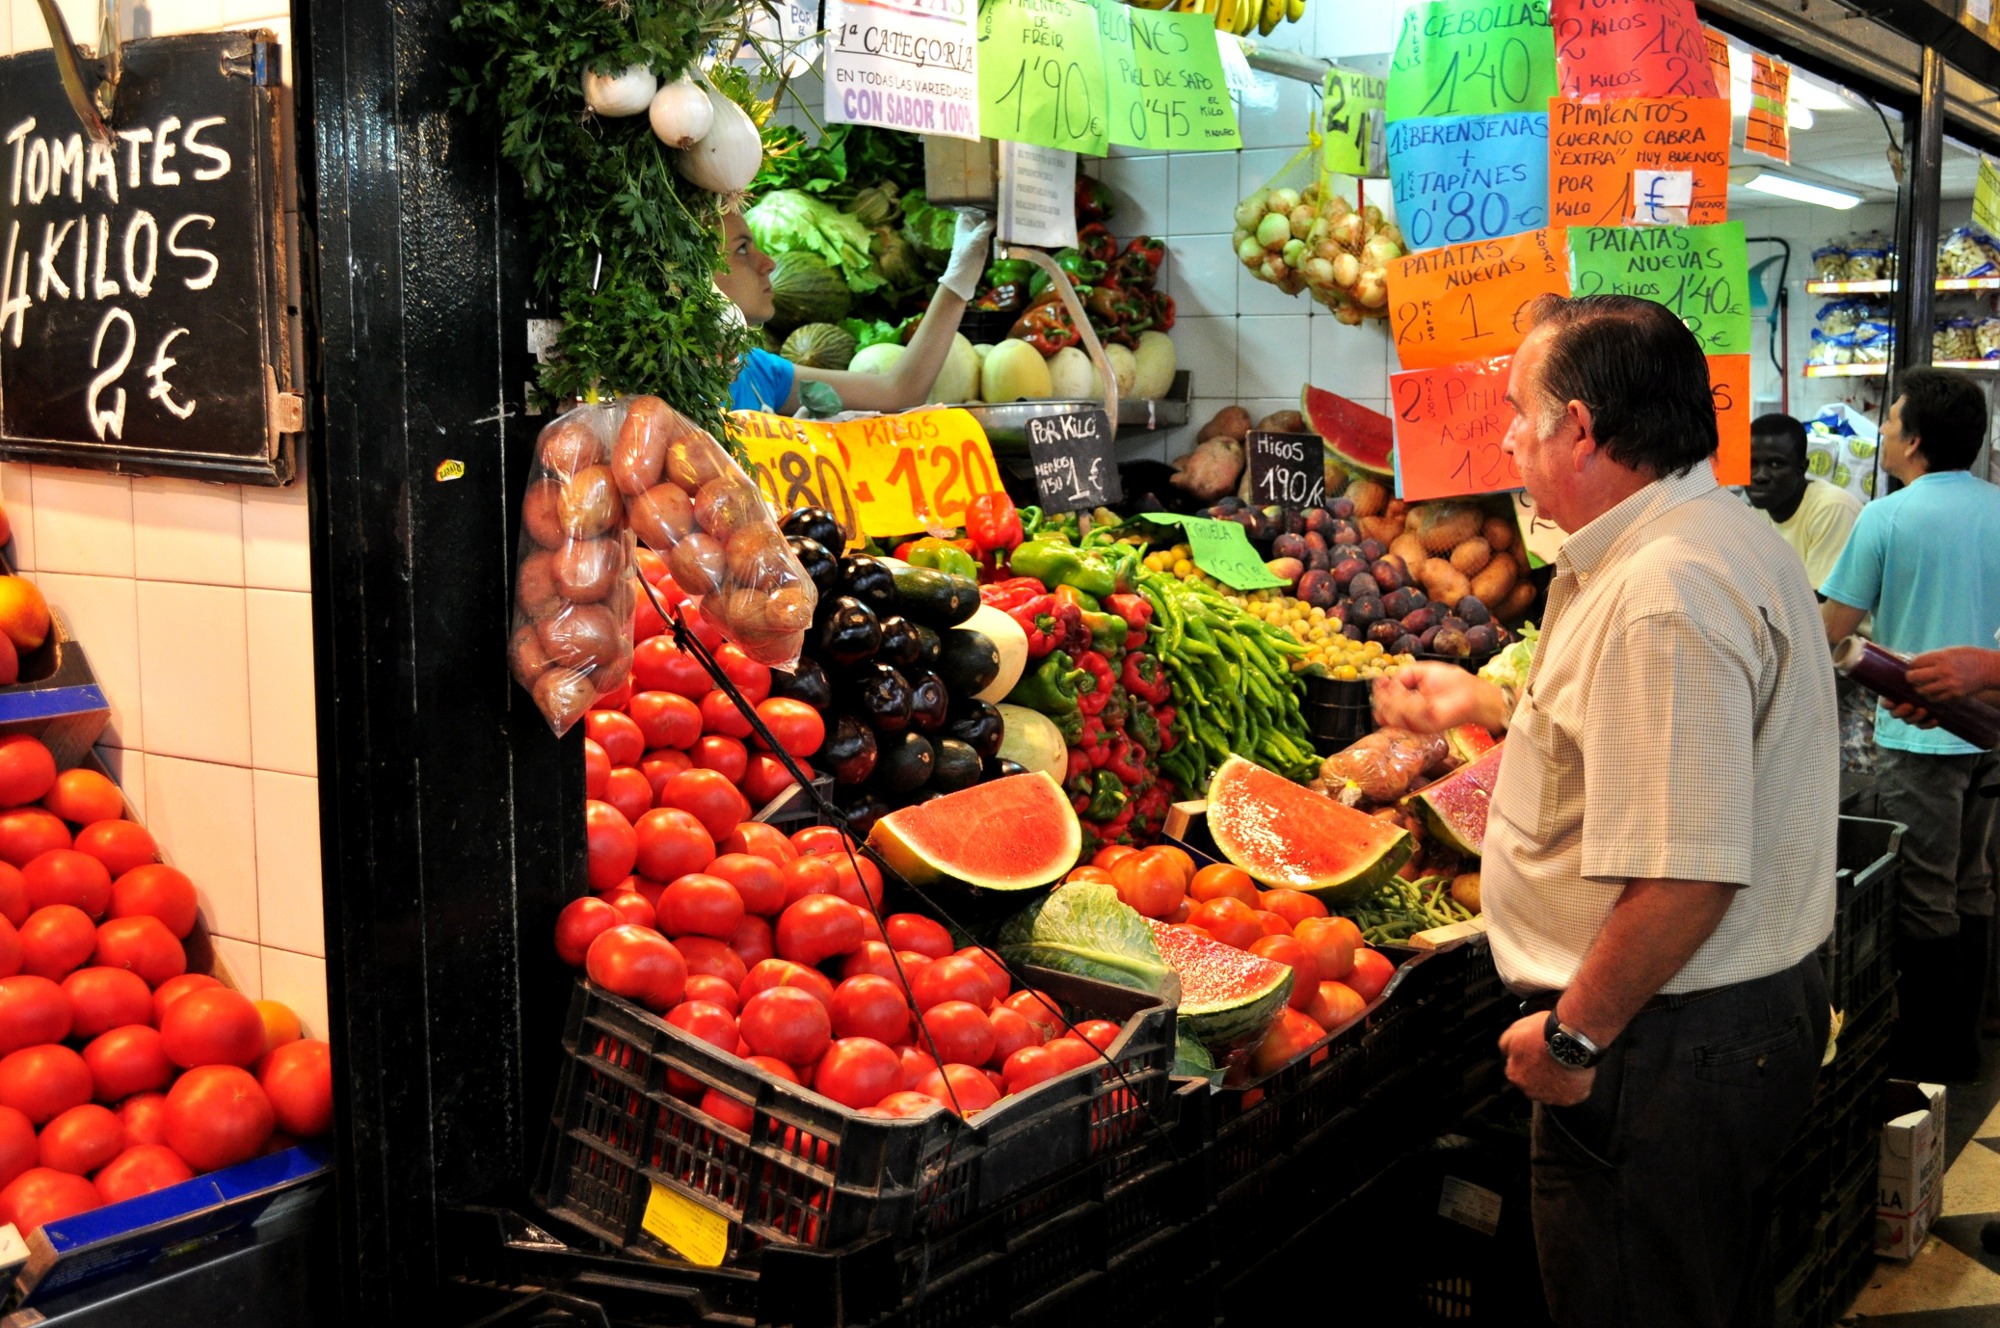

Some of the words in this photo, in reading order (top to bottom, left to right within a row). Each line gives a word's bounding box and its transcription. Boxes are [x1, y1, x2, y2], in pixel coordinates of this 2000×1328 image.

[1034, 16, 1049, 29] DE
[1424, 1, 1549, 37] CEBOLLAS
[864, 26, 973, 70] CATEGORÍA
[1559, 18, 1586, 61] 2
[836, 68, 854, 82] EN
[858, 70, 894, 88] TODAS
[1154, 68, 1176, 87] DE
[1179, 69, 1213, 90] SAPO
[1418, 37, 1531, 117] 1'40
[1666, 57, 1696, 98] 2
[844, 88, 882, 122] CON
[887, 93, 935, 129] SABOR
[1130, 98, 1190, 141] 0'45
[1409, 116, 1549, 148] BERENJENAS
[1556, 130, 1633, 147] CUERNO
[1644, 127, 1706, 145] CABRA
[7, 116, 231, 204] TOMATES
[1636, 151, 1661, 165] MUY
[1668, 151, 1725, 166] BUENOS
[1558, 175, 1594, 194] POR
[1411, 190, 1510, 246] 0'80
[1586, 226, 1689, 252] PATATAS
[1399, 241, 1504, 278] PATATAS
[1445, 254, 1526, 291] NUEVAS
[1627, 247, 1723, 273] NUEVAS
[1398, 301, 1424, 345] 2
[1460, 293, 1494, 341] 1
[87, 306, 136, 442] 2
[148, 328, 196, 421] €
[1398, 378, 1421, 423] 2
[1031, 419, 1061, 444] POR
[1440, 413, 1500, 446] ASAR
